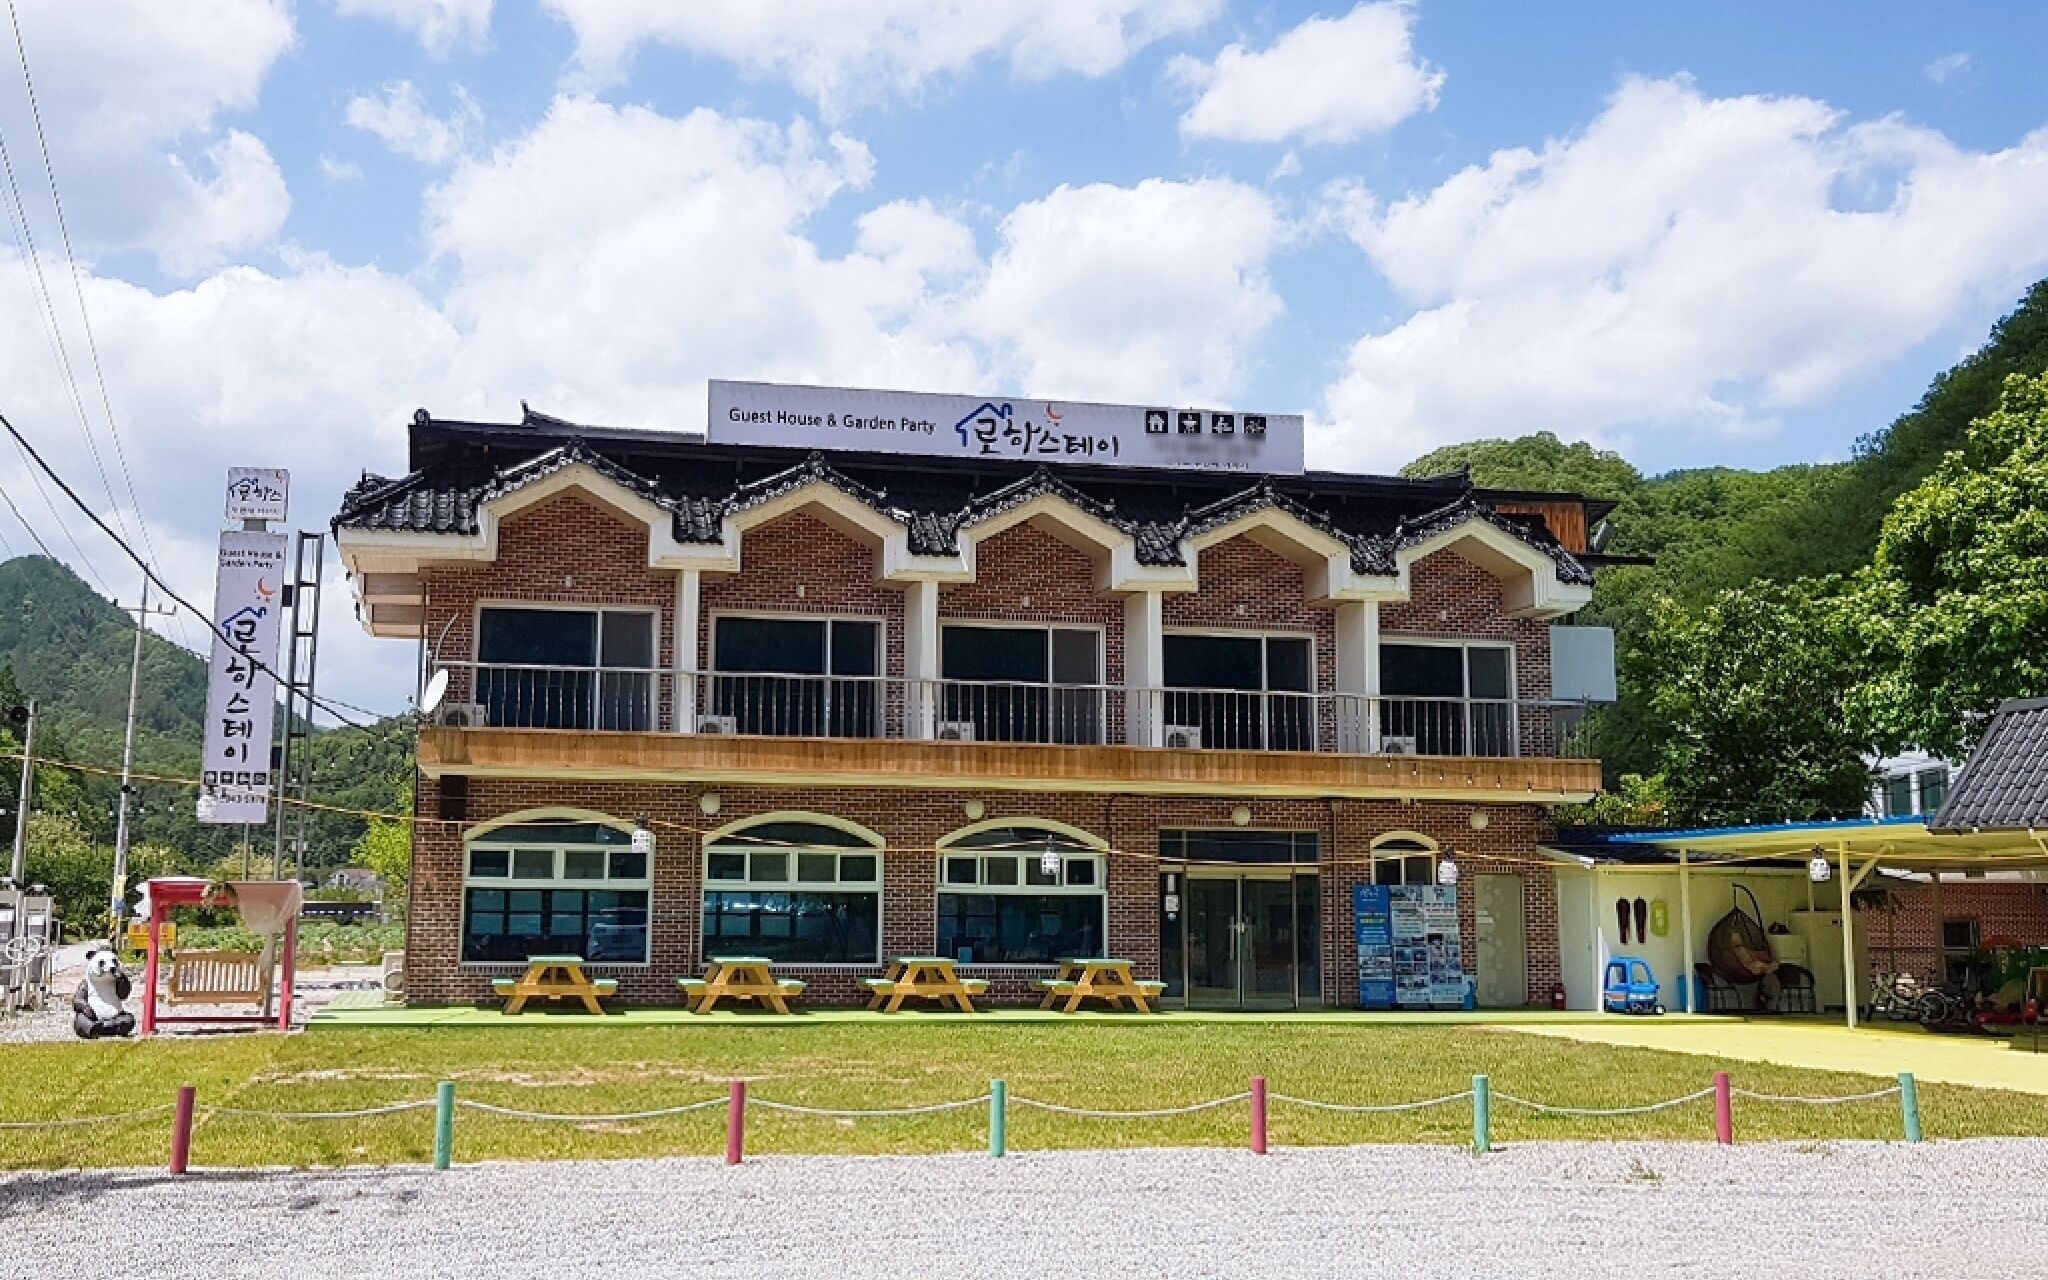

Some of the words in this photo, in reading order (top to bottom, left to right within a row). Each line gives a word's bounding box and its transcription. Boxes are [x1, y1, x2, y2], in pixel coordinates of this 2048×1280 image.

[728, 407, 772, 424] Guest
[777, 410, 822, 427] House
[827, 413, 837, 427] &
[843, 414, 896, 430] Garden
[901, 416, 936, 435] Party
[974, 418, 1119, 457] 로하스테이
[222, 619, 265, 763] 로하스테이
